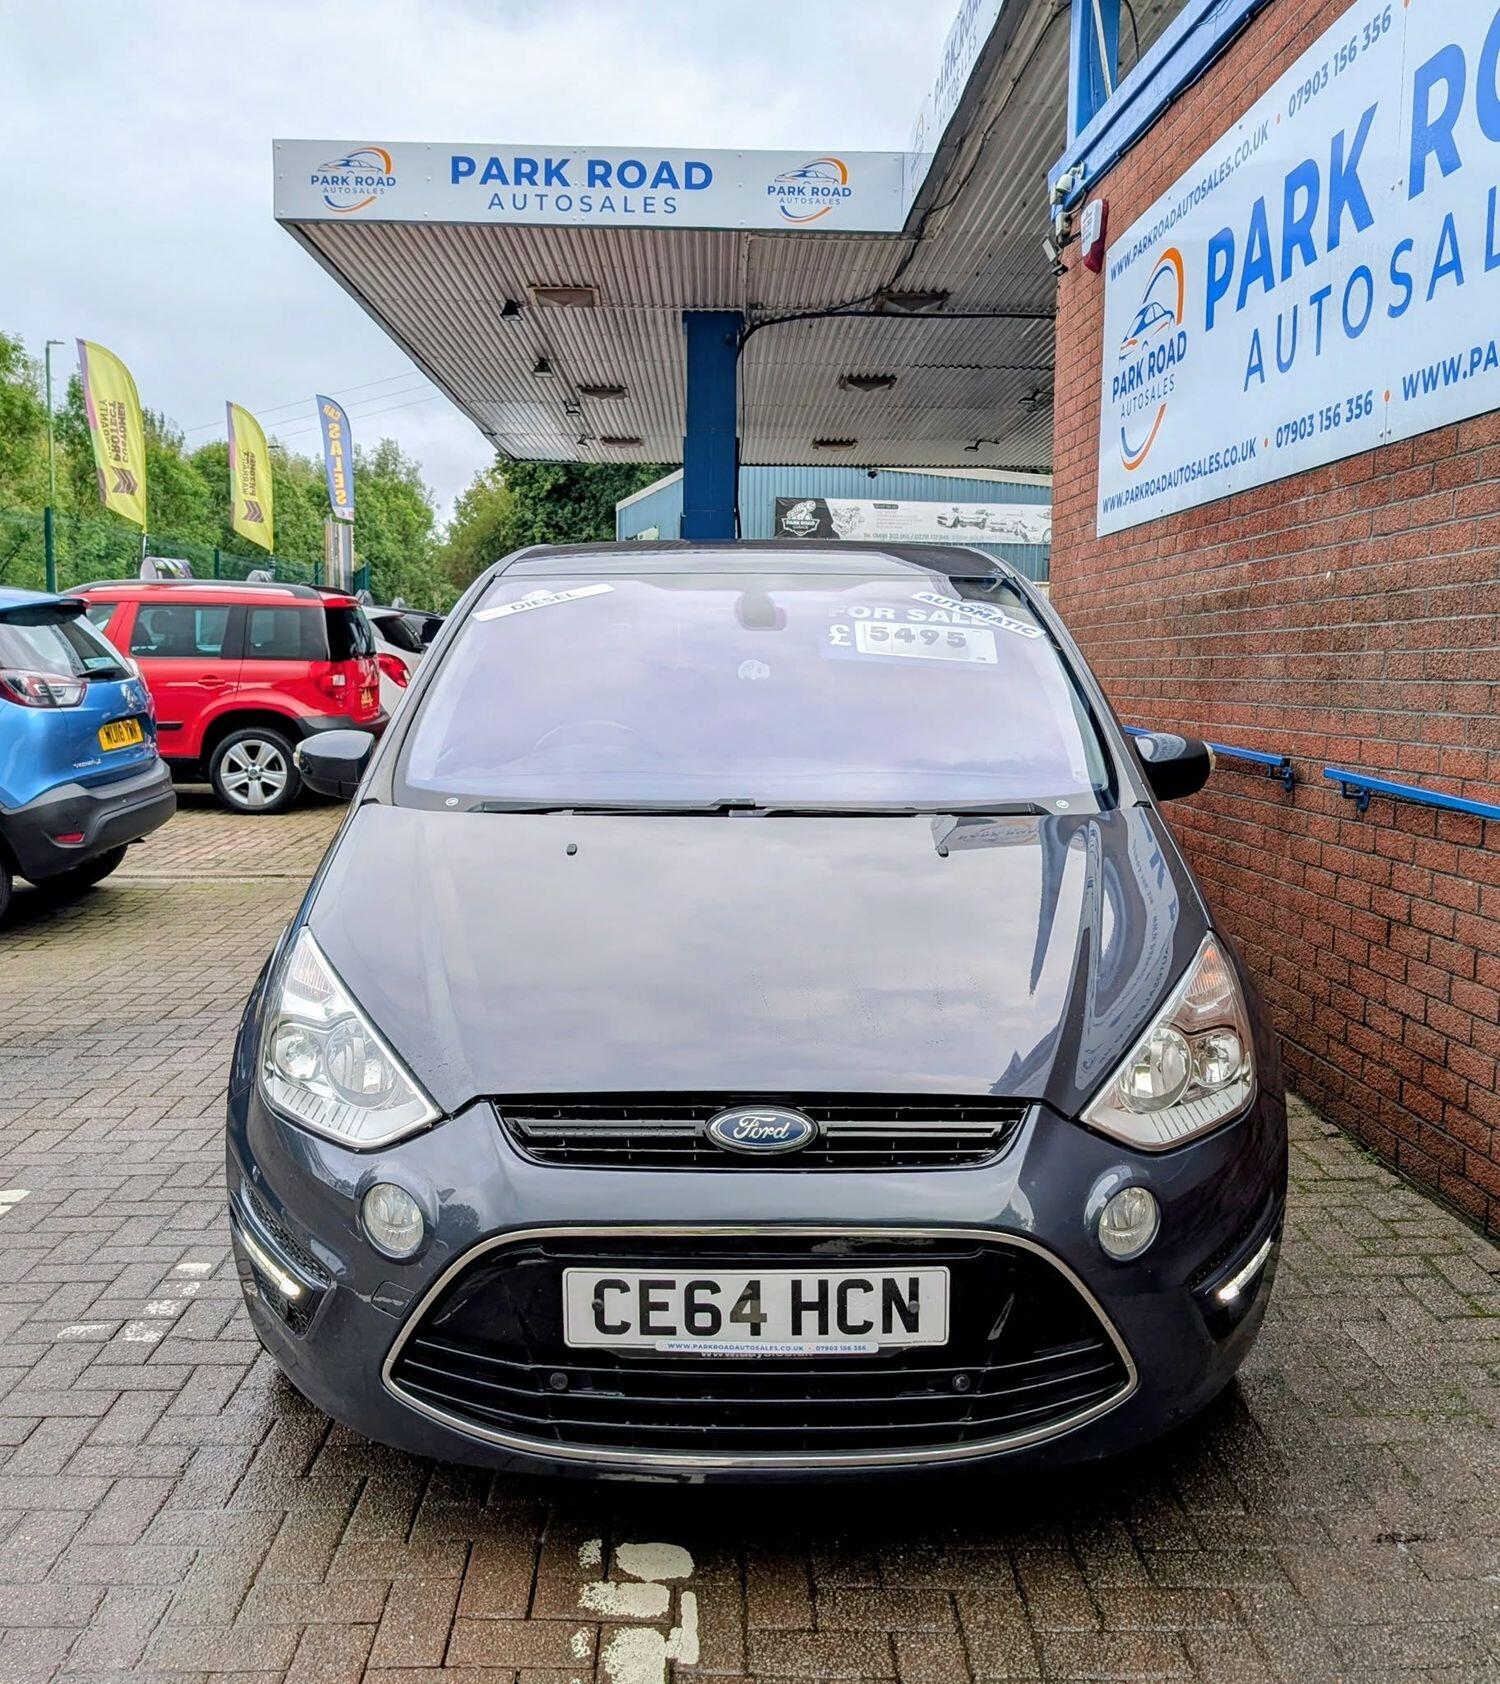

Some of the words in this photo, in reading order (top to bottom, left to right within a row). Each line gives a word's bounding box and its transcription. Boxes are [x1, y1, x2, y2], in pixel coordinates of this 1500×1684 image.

[1110, 120, 1269, 280] WWW.PARKROADAUTOSALES.CO.UK
[1288, 66, 1329, 118] 07903
[1333, 43, 1357, 76] 156
[1362, 4, 1393, 52] 356
[311, 175, 350, 186] PARK
[355, 176, 396, 187] ROAD
[451, 156, 571, 187] PARK
[587, 159, 714, 190] ROAD
[322, 186, 385, 195] AUTOSALES
[767, 185, 806, 196] PARK
[811, 186, 852, 197] ROAD
[779, 197, 841, 206] AUTOSALES
[488, 193, 677, 214] AUTOSALES
[1205, 101, 1379, 332] PARK
[1112, 357, 1144, 404] PARK
[1147, 330, 1187, 380] ROAD
[1120, 373, 1175, 420] AUTOSALES
[1102, 436, 1257, 514] WWW.PARKROADAUTOSALES.CO.UK
[1275, 416, 1315, 449] 07903
[1318, 405, 1341, 434] 156
[1345, 389, 1373, 424] 356
[510, 593, 578, 611] DIESEL
[828, 606, 896, 620] FOR
[920, 595, 1037, 635] AUTOMATIC
[828, 624, 851, 646] £
[869, 626, 967, 649] 5495
[733, 1116, 790, 1139] Ford
[593, 1278, 768, 1336] CE64
[791, 1277, 920, 1334] HCN
[667, 1342, 804, 1352] WWW.PARKROADAUTOSALES.CO.UK
